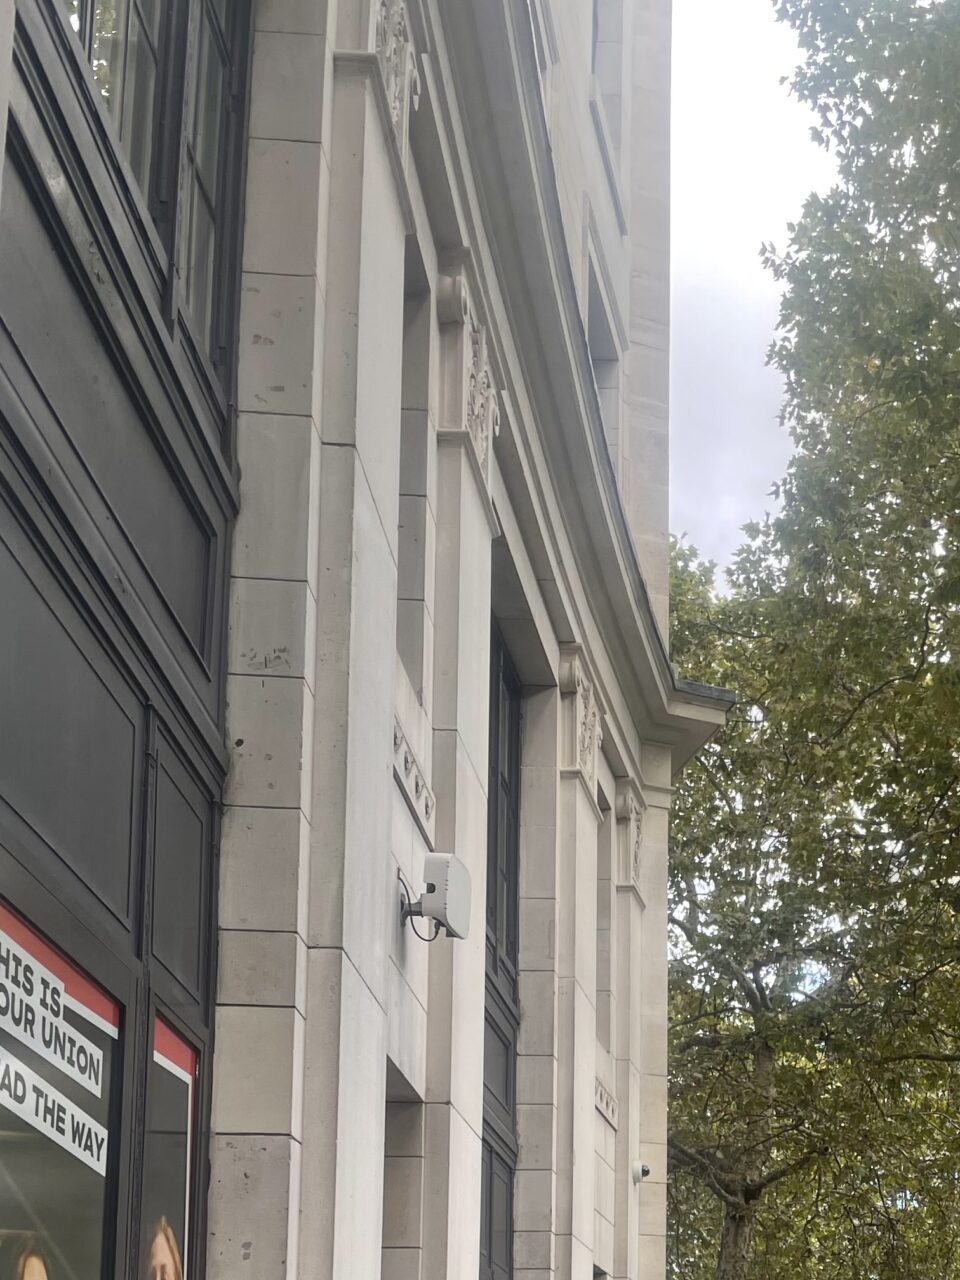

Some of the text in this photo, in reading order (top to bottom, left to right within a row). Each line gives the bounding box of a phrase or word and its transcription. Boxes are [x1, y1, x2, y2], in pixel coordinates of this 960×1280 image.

[40, 976, 61, 1018] IS
[42, 1015, 100, 1086] UNION
[32, 1083, 67, 1136] THE
[71, 1113, 105, 1162] WAY
